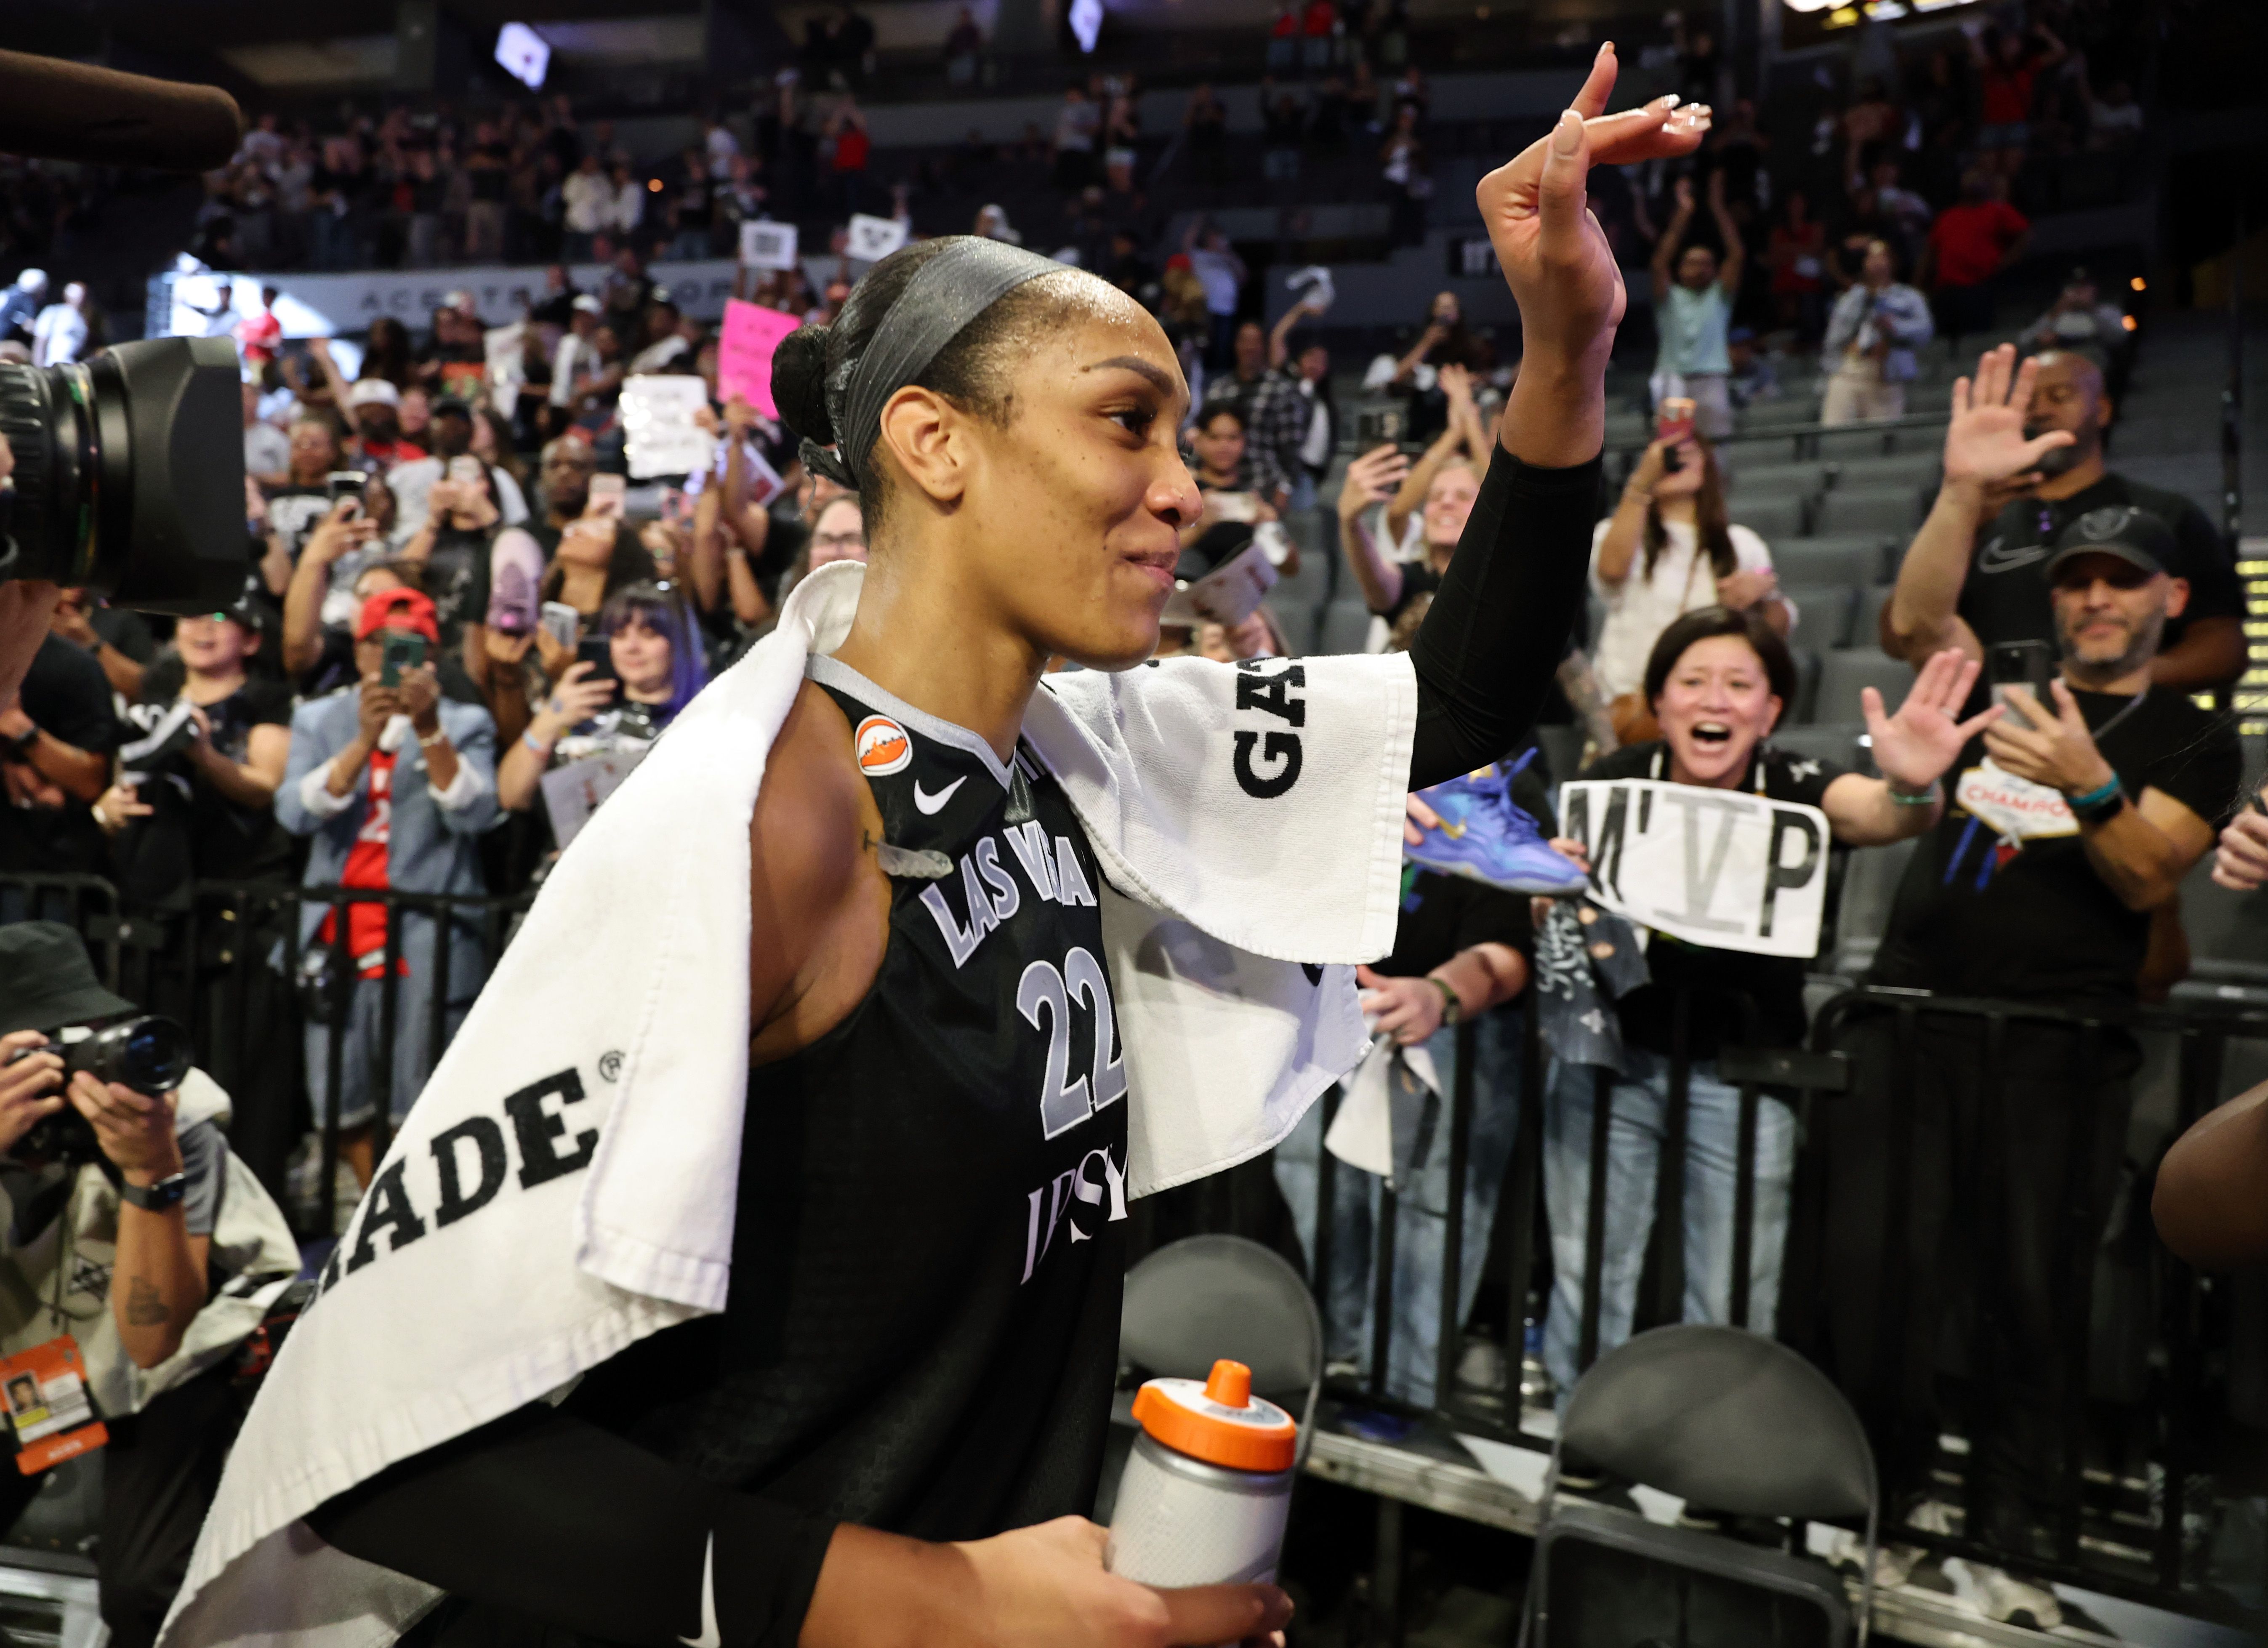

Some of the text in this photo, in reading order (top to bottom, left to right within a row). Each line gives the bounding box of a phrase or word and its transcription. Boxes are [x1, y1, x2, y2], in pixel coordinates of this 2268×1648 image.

[1234, 656, 1305, 799] GA
[919, 836, 1020, 968] LAS
[1017, 946, 1129, 1140] 22
[322, 1066, 599, 1295] ADE
